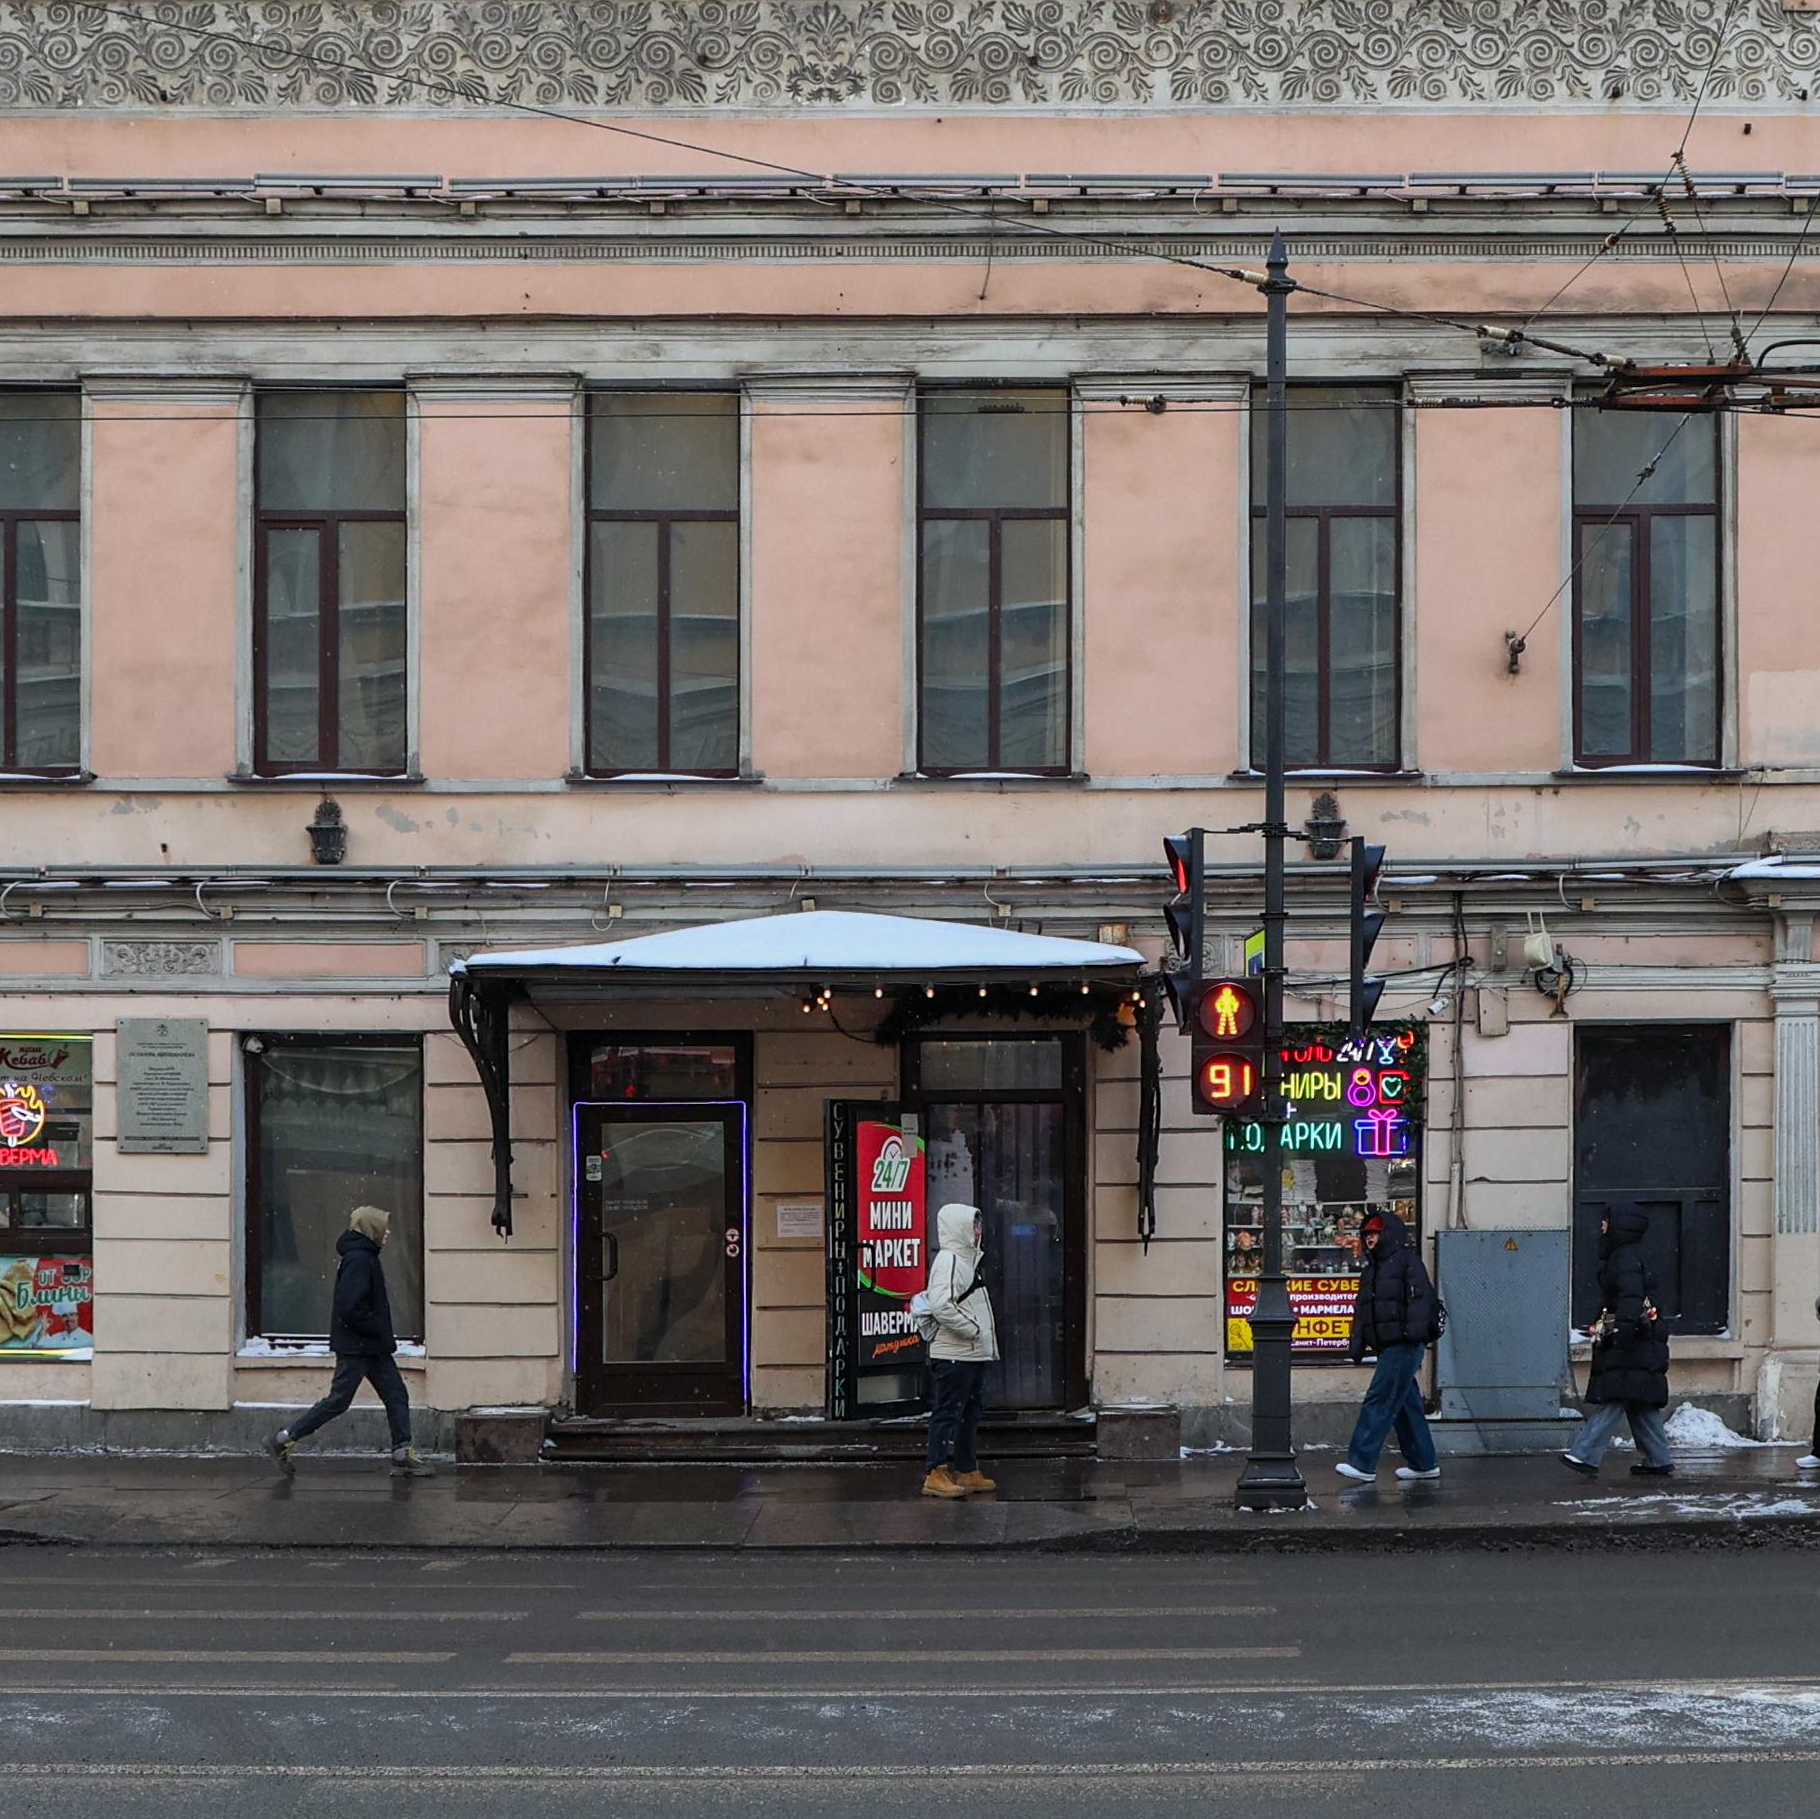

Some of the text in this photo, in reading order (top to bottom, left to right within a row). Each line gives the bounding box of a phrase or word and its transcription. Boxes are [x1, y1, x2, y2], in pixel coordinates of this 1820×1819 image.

[1209, 1065, 1251, 1099] 91
[1280, 1072, 1341, 1100] НИРЫ
[1226, 1123, 1342, 1152] ОАРКИ
[874, 1160, 908, 1189] 24/7
[870, 1201, 912, 1230] МИНИ
[862, 1238, 921, 1269] МАРКЕТ
[39, 1268, 55, 1286] ОТ
[1318, 1280, 1359, 1291] СУВЕ
[16, 1281, 90, 1310] Блины
[1300, 1305, 1355, 1315] МАРМЕЛА
[1297, 1321, 1353, 1335] НФЕТ
